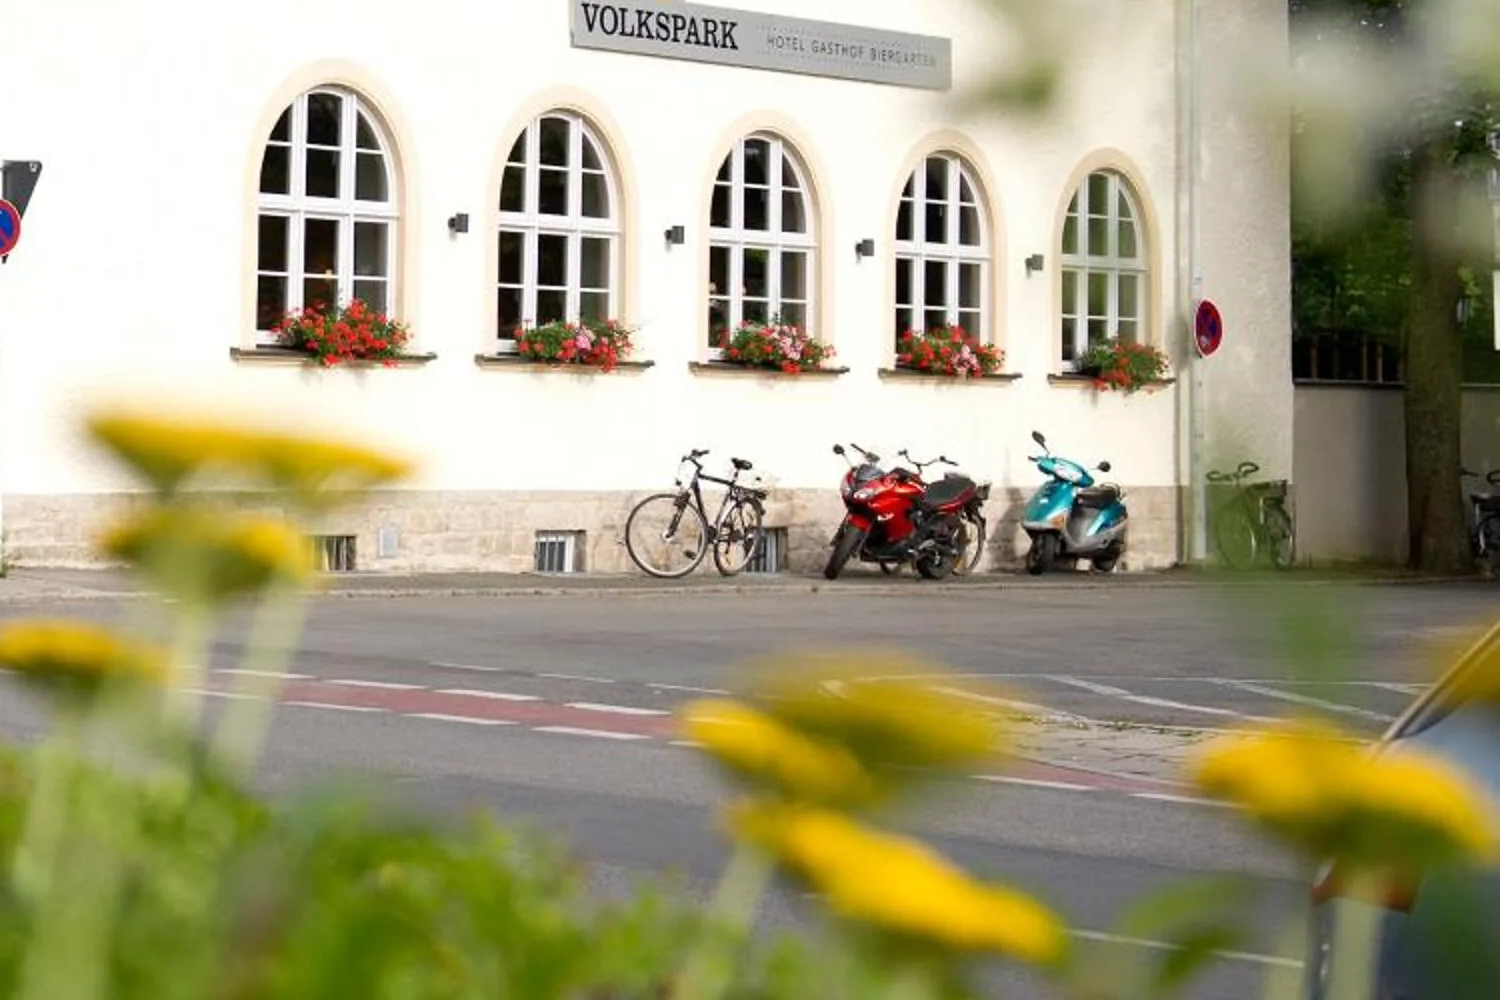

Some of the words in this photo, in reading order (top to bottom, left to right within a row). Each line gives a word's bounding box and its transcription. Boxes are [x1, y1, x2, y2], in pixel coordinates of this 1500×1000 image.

[581, 2, 739, 50] VOLKSPARK
[766, 34, 806, 53] HOTEL
[811, 39, 865, 60] GASTHOF
[869, 47, 938, 67] BIERGARTEN
